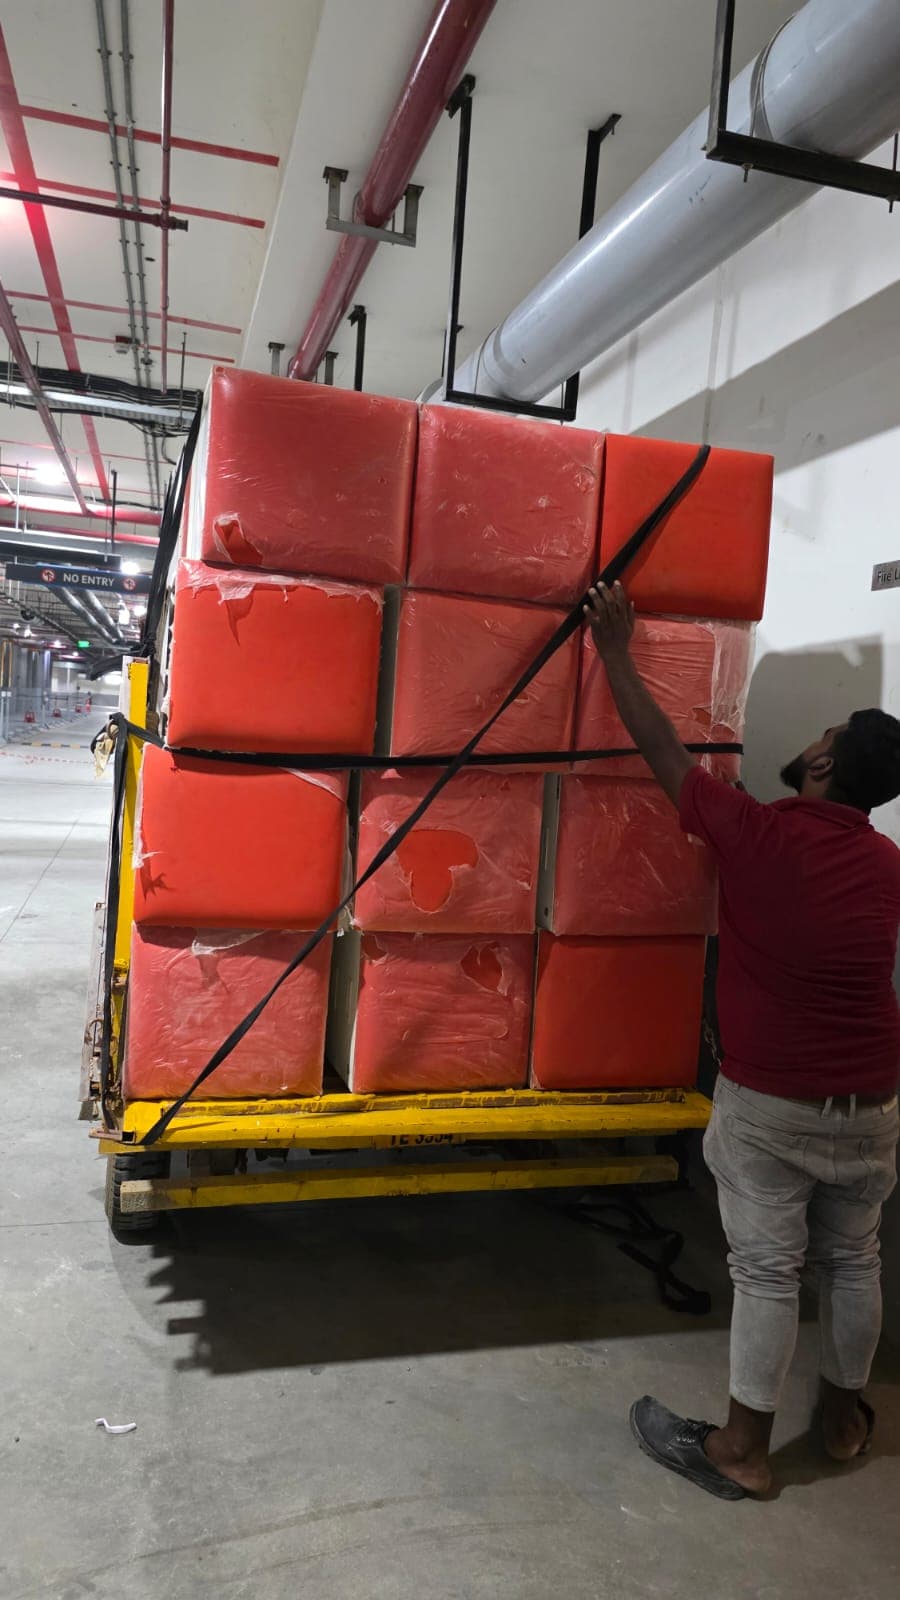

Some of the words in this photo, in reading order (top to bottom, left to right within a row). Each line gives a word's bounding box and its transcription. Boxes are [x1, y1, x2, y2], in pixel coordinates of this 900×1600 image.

[63, 573, 79, 583] NO
[81, 576, 115, 587] ENTRY
[877, 570, 892, 583] Fire
